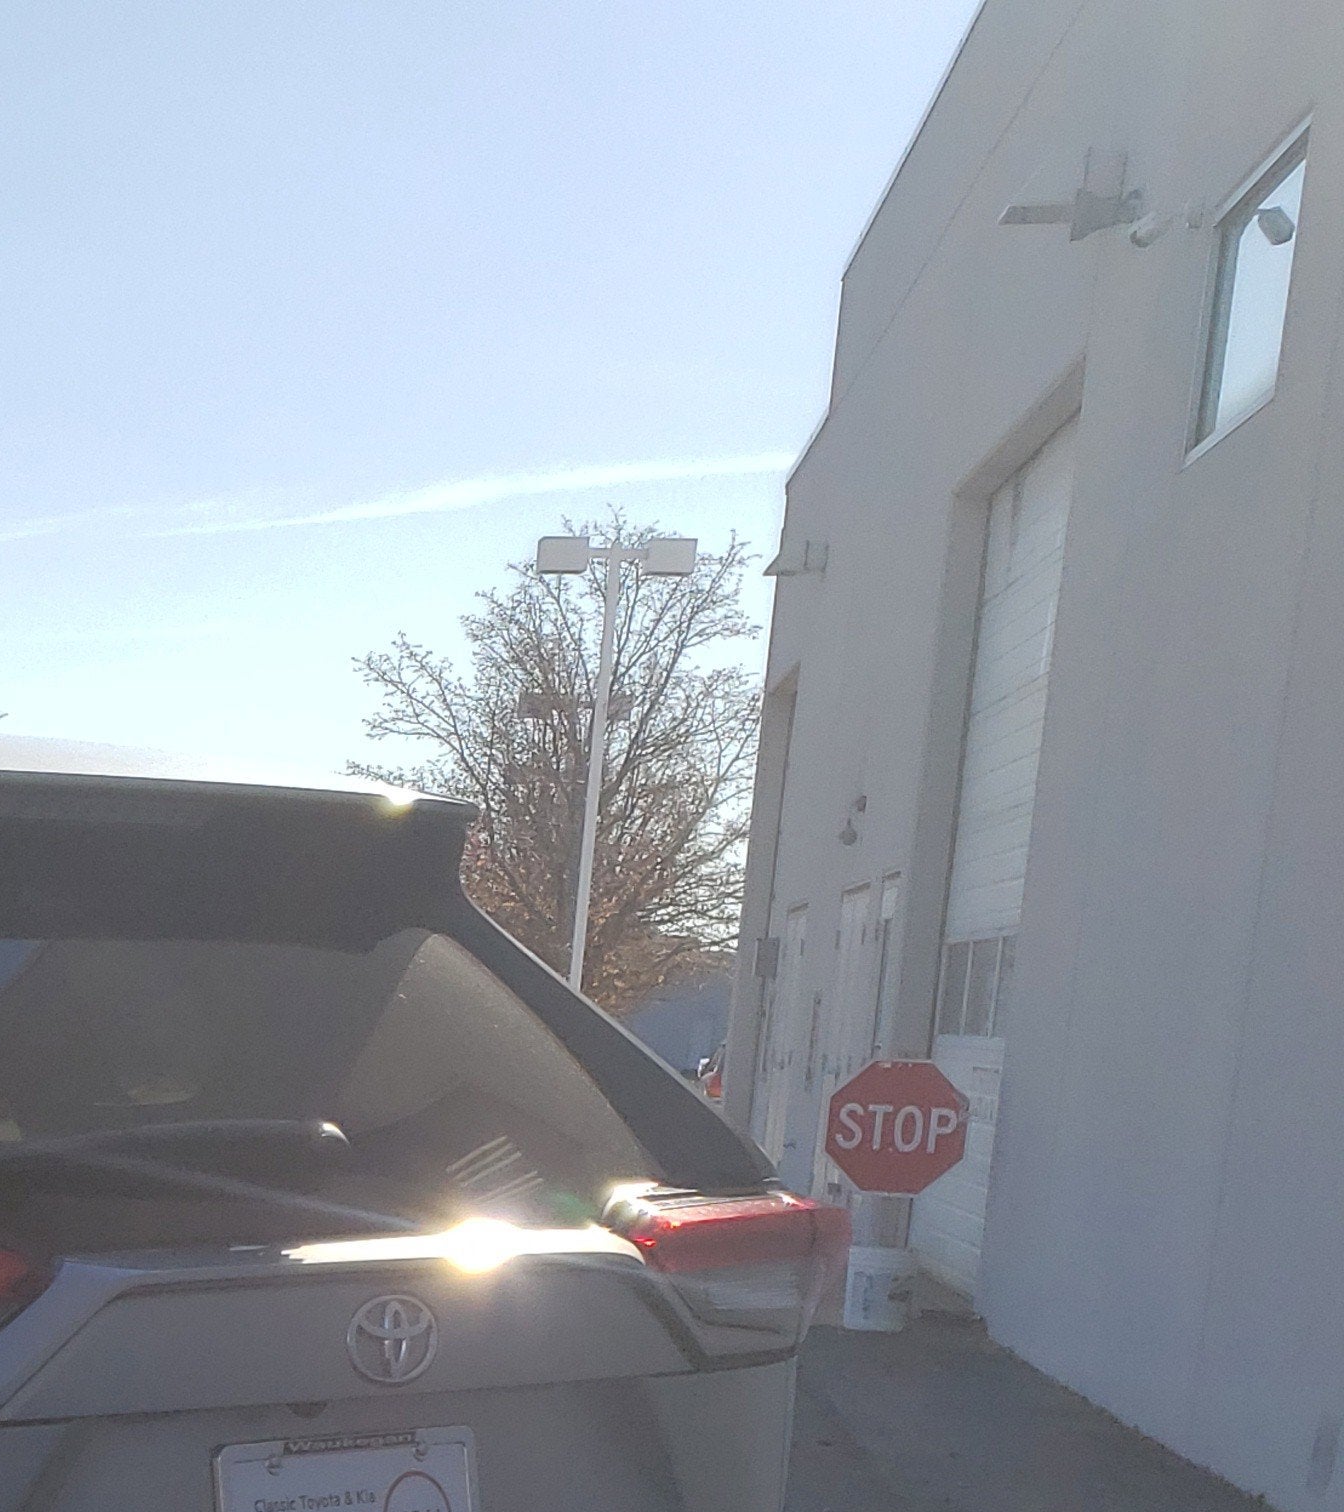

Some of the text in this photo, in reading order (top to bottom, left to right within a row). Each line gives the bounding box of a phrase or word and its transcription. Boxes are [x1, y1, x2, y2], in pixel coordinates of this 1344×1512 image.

[834, 1102, 958, 1154] STOP
[287, 1433, 413, 1453] Waukegan
[299, 1493, 341, 1512] Toyota
[345, 1491, 353, 1506] &
[357, 1489, 377, 1504] Kia
